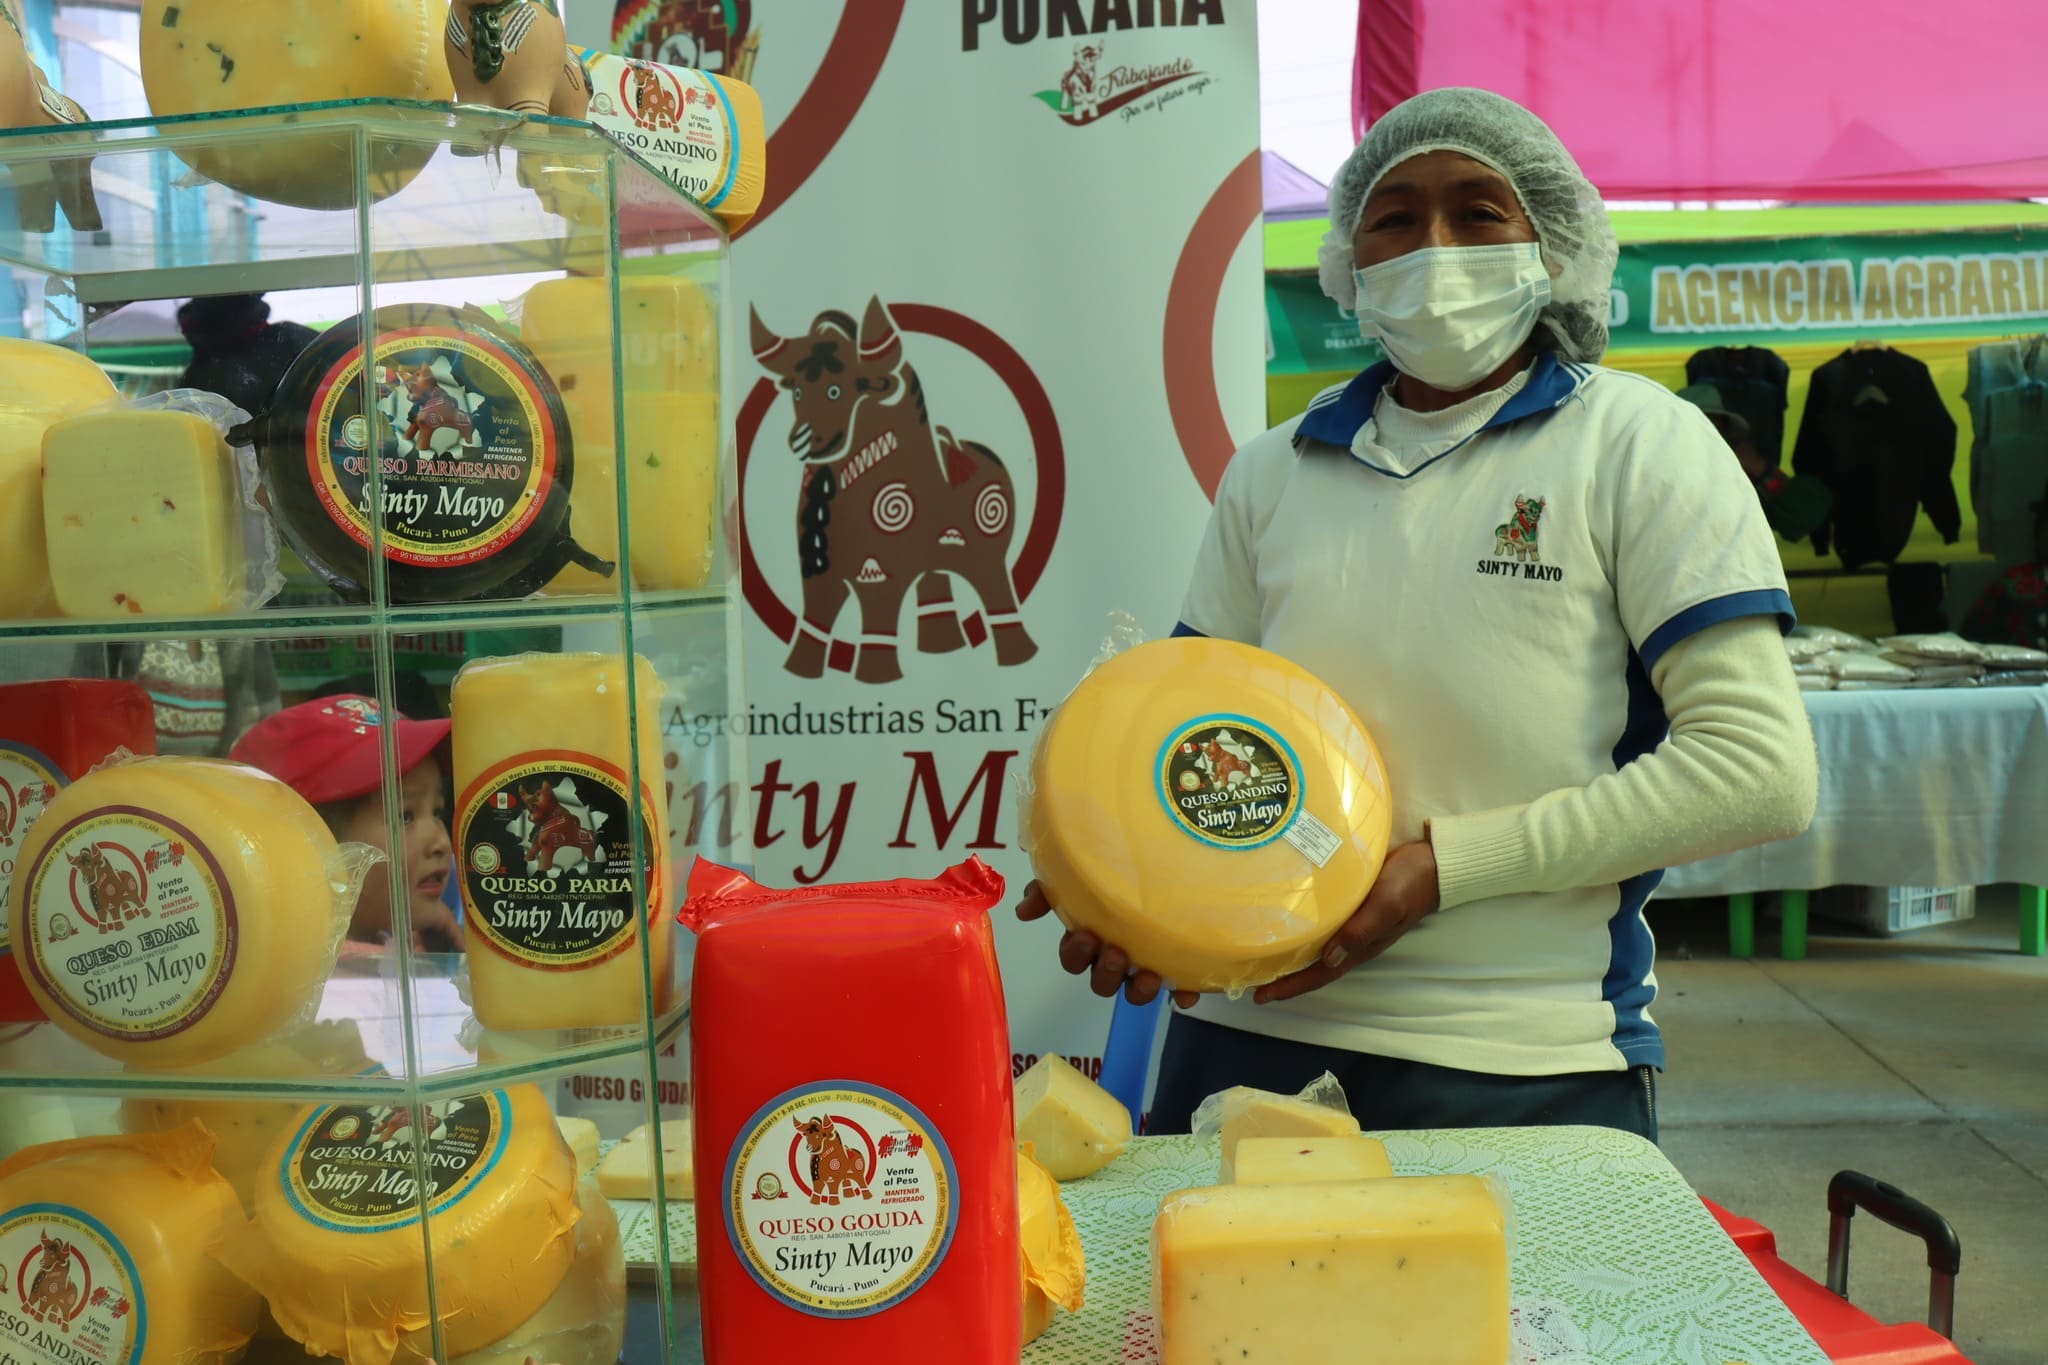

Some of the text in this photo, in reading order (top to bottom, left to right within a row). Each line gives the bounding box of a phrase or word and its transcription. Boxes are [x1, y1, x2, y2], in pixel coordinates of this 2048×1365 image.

[653, 138, 717, 162] ANDINO
[661, 165, 708, 194] Mayo
[1652, 262, 1856, 332] AGENCIA
[492, 415, 519, 426] Venta
[499, 426, 509, 435] al
[494, 436, 517, 445] Peso
[483, 454, 527, 463] REFRIGERADO
[487, 446, 523, 454] MANTENER
[416, 459, 521, 480] PARMESANO
[435, 486, 505, 527] Mayo
[396, 521, 432, 539] Pucará
[442, 527, 469, 539] Puno
[1477, 560, 1563, 581] SINTY MAYO
[664, 701, 924, 747] Agroindustrias
[936, 701, 1002, 733] San
[1181, 790, 1229, 809] QUESO
[1232, 782, 1288, 804] ANDINO
[1197, 808, 1237, 830] Sinty
[1240, 801, 1283, 824] Mayo
[157, 876, 184, 891] Venta
[481, 876, 632, 894] QUESO PARIA
[158, 886, 189, 901] al Peso
[492, 900, 624, 938] Sinty Mayo
[67, 939, 132, 976] QUESO
[138, 917, 200, 953] EDAM
[523, 935, 590, 950] Pucará Puno
[84, 975, 139, 1007] Sinty
[145, 951, 207, 988] Mayo
[121, 992, 181, 1018] Pucará Puno
[573, 1075, 690, 1105] QUESO GUDA
[454, 1123, 479, 1135] Venta
[310, 1146, 377, 1162] QUESO
[308, 1163, 368, 1199] Sinty
[884, 1176, 919, 1186] al Peso
[886, 1167, 914, 1177] Venta
[881, 1195, 925, 1205] REFRIGERADO
[885, 1187, 920, 1196] MANTENER
[366, 1203, 392, 1213] Puno
[759, 1209, 924, 1239] QUESO GOUDA
[775, 1241, 914, 1277] Sinty Mayo
[809, 1278, 880, 1294] Pucará Puno
